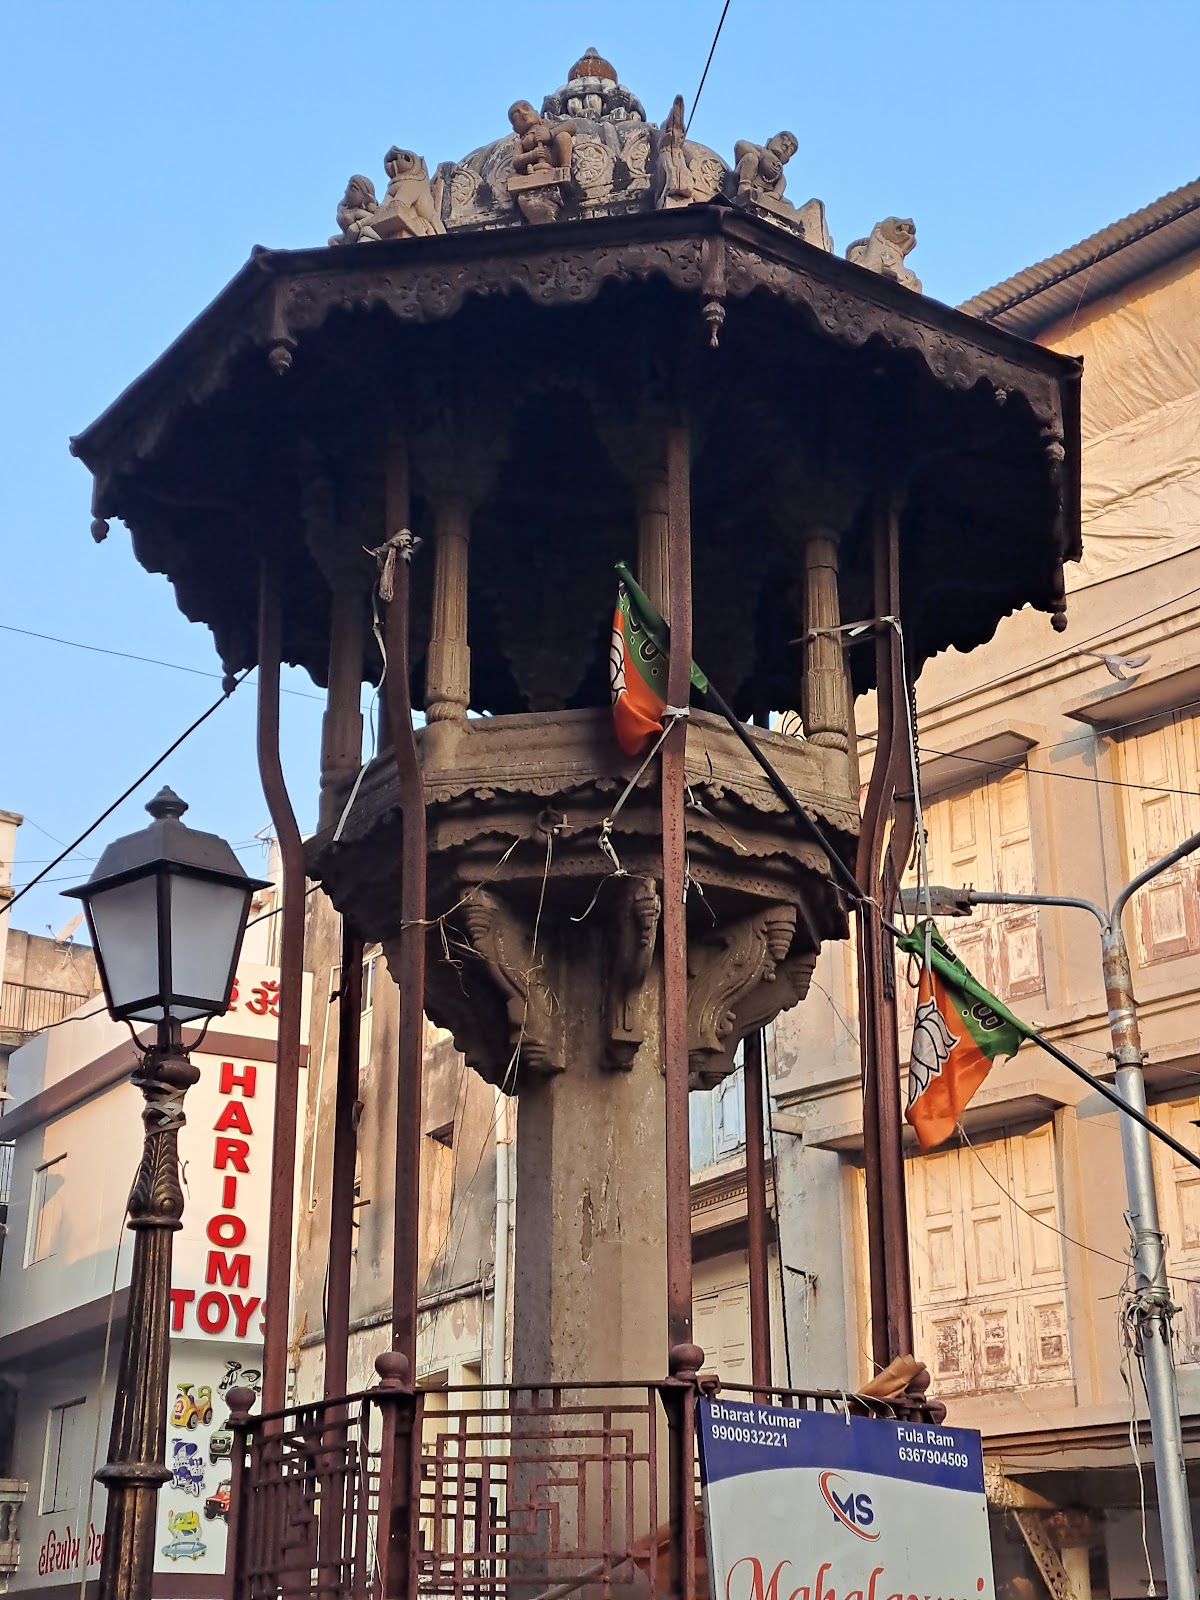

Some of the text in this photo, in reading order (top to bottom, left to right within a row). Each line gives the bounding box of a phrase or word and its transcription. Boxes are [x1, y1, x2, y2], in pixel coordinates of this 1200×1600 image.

[710, 1403, 801, 1429] Bharat Kumar
[711, 1424, 788, 1448] 9900932221
[897, 1427, 955, 1447] Fula Ram
[898, 1446, 969, 1468] 6367904509
